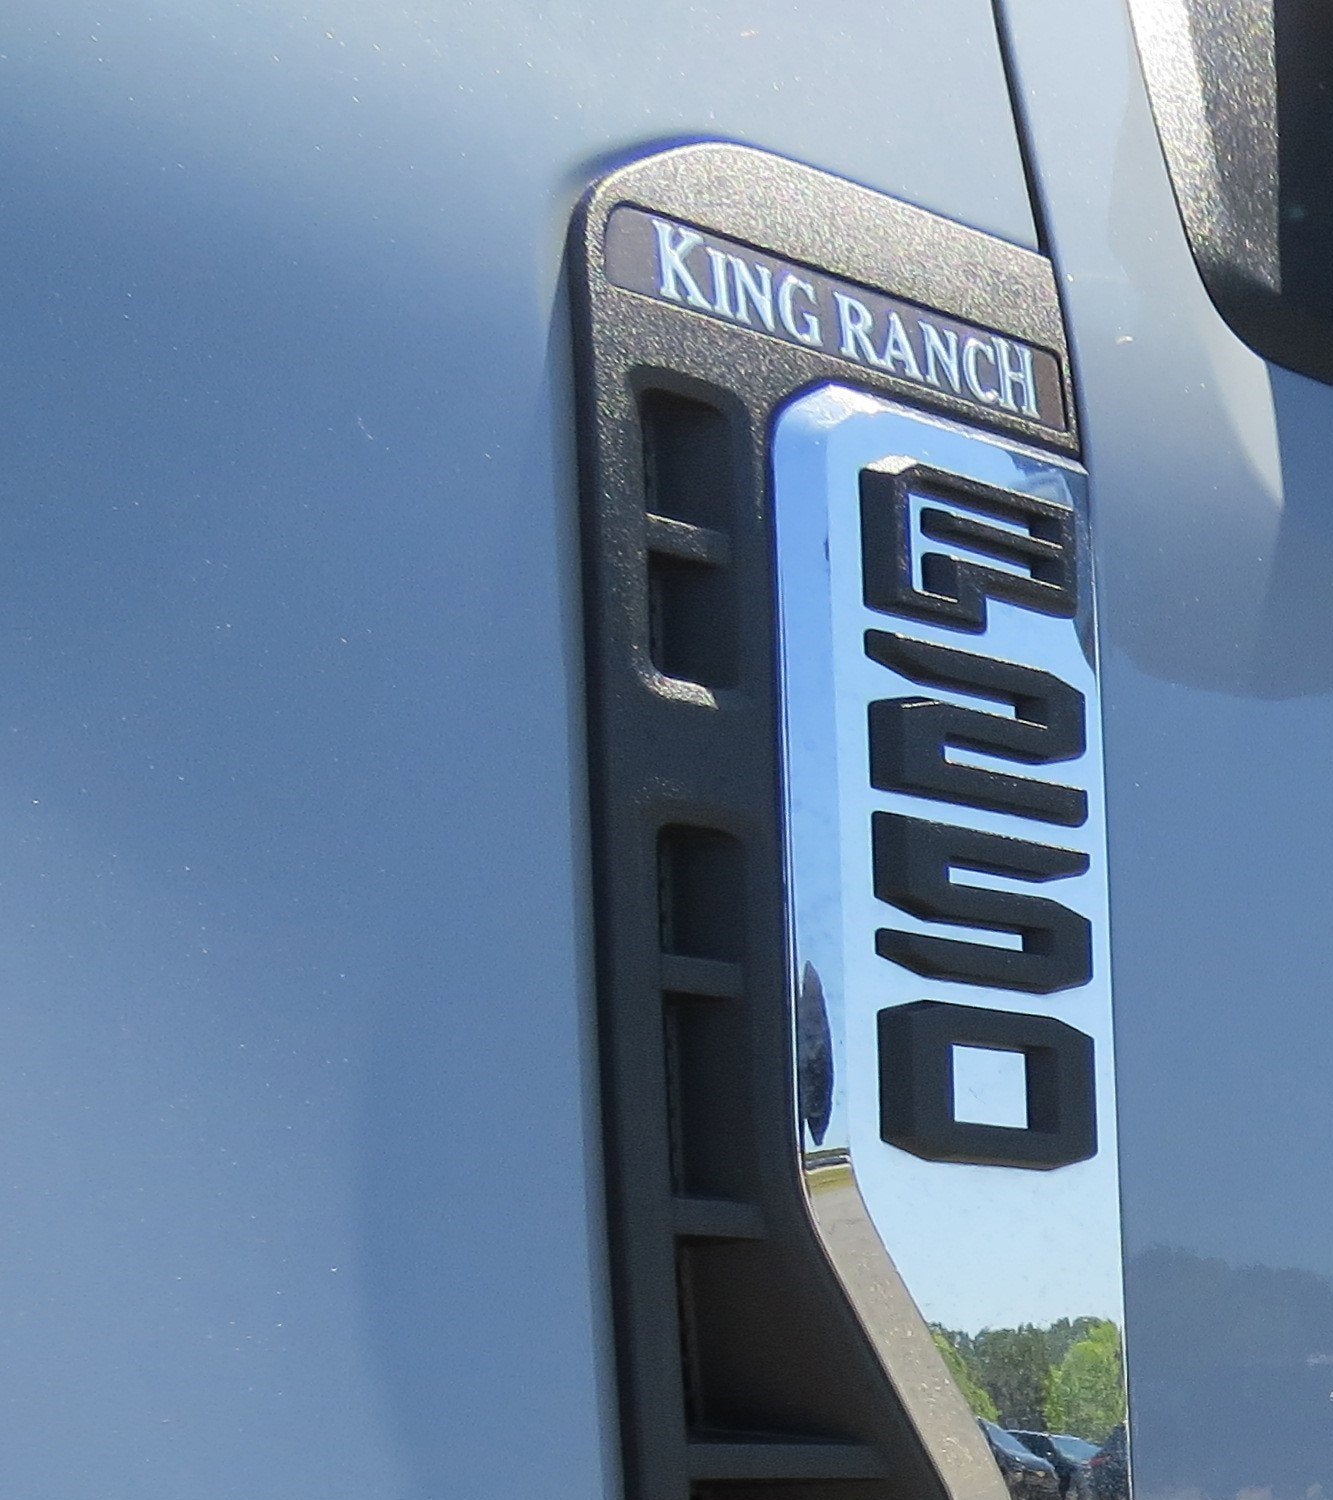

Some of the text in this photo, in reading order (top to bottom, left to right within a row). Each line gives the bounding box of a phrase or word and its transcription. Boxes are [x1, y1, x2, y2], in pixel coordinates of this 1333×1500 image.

[651, 216, 1040, 420] KING RANCH
[859, 455, 1098, 1171] F250
